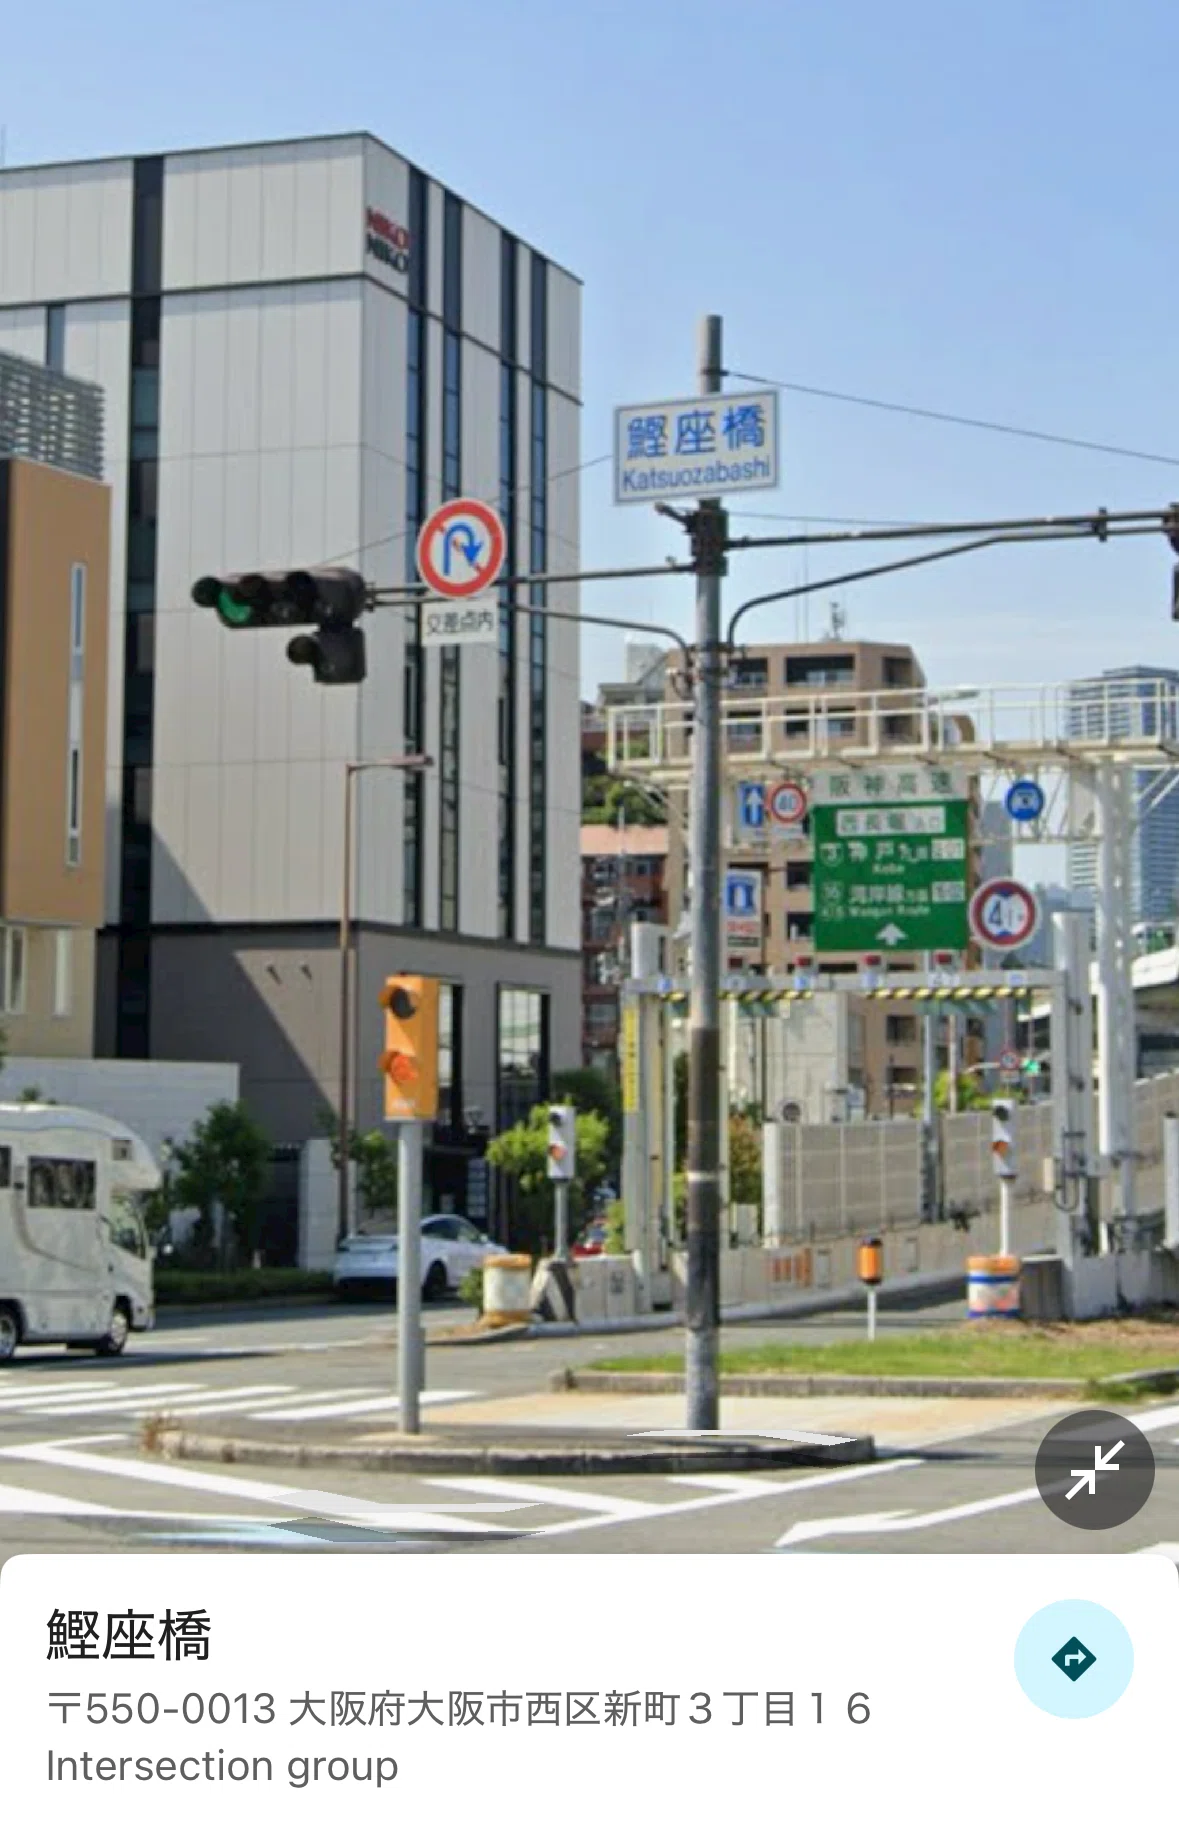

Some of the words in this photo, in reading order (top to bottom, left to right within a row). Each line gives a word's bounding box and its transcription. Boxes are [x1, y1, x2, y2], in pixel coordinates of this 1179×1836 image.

[627, 404, 766, 461] 鰹座橋
[623, 455, 770, 491] Katsuozabashi
[427, 608, 494, 636] 交差点内
